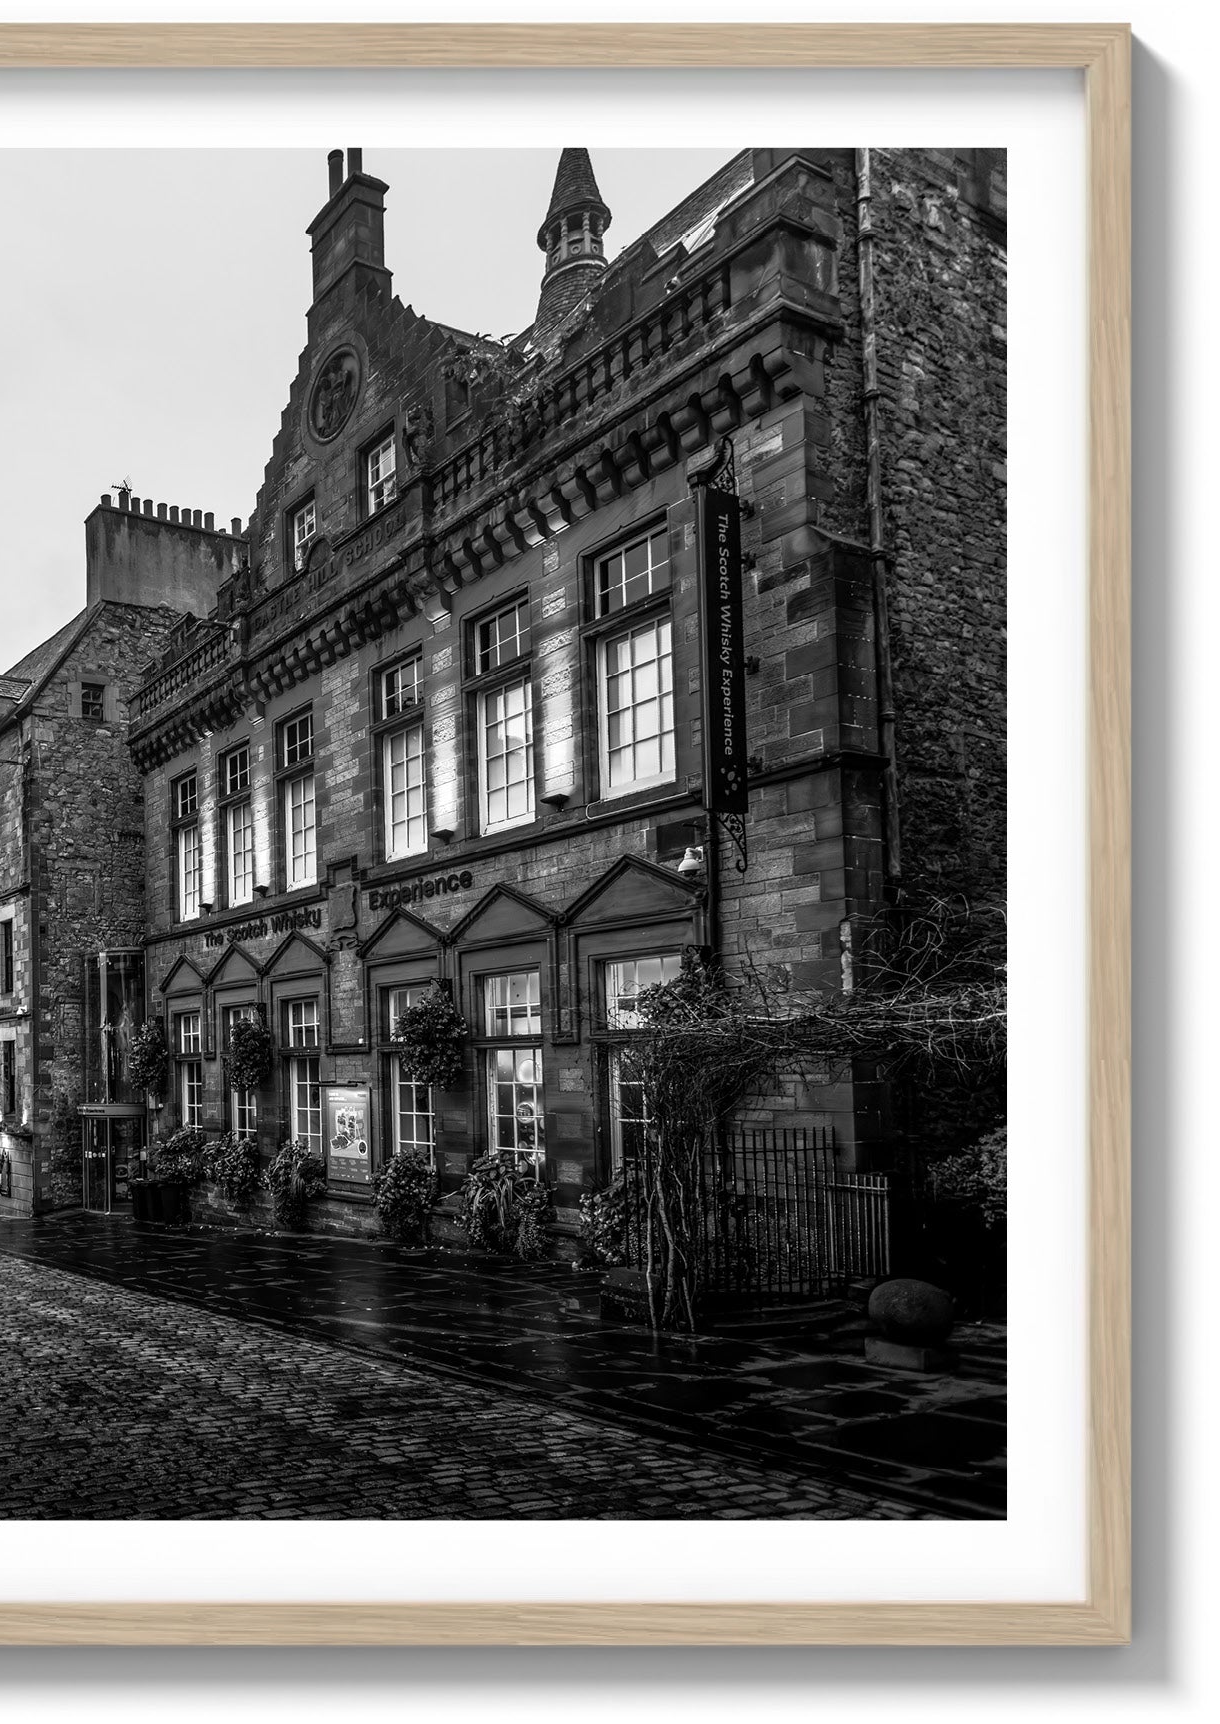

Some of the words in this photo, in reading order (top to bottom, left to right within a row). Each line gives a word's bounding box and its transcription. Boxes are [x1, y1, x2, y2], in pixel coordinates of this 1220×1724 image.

[718, 513, 729, 543] The
[718, 546, 731, 601] Scotch
[718, 604, 732, 666] Whisky
[720, 668, 734, 756] Experience
[204, 931, 224, 948] The
[226, 918, 268, 943] Scotch
[270, 907, 322, 934] Whisky
[368, 870, 473, 911] Experience
